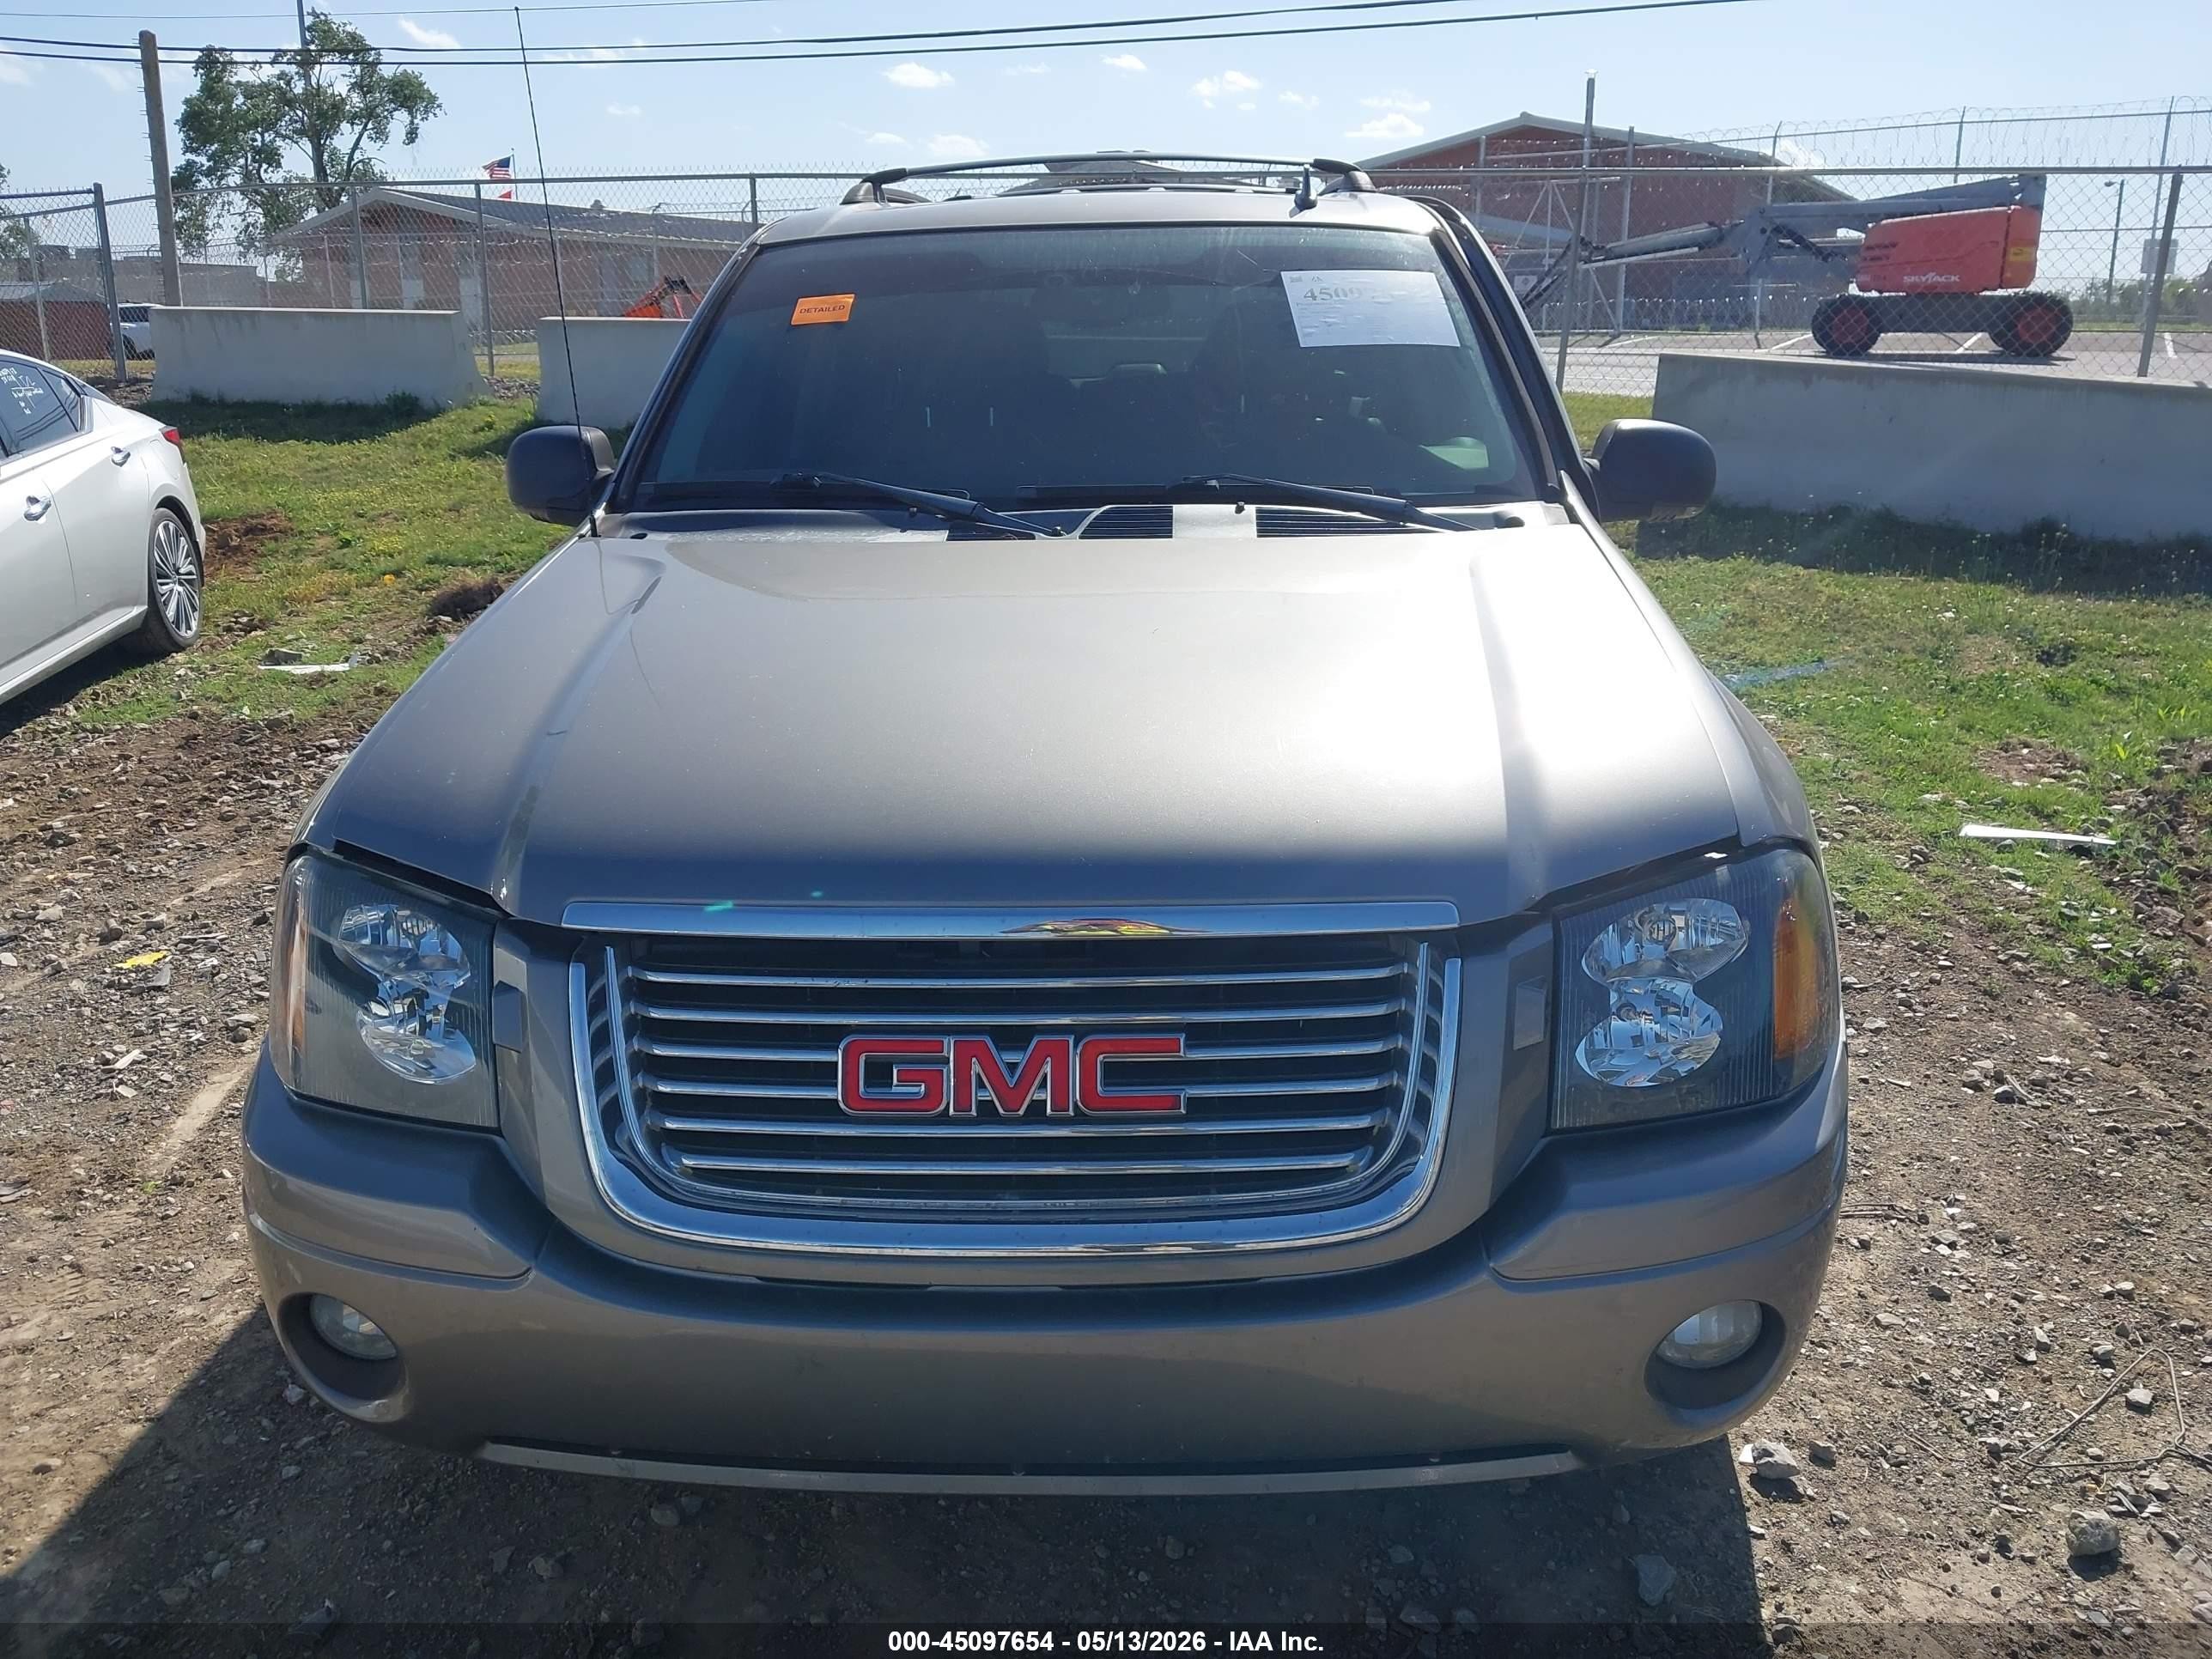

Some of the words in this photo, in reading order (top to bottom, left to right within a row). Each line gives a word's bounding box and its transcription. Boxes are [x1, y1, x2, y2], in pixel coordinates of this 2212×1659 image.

[1903, 271, 1960, 283] SKYJACK
[799, 304, 845, 313] DETAILED
[837, 1034, 1187, 1118] GMC
